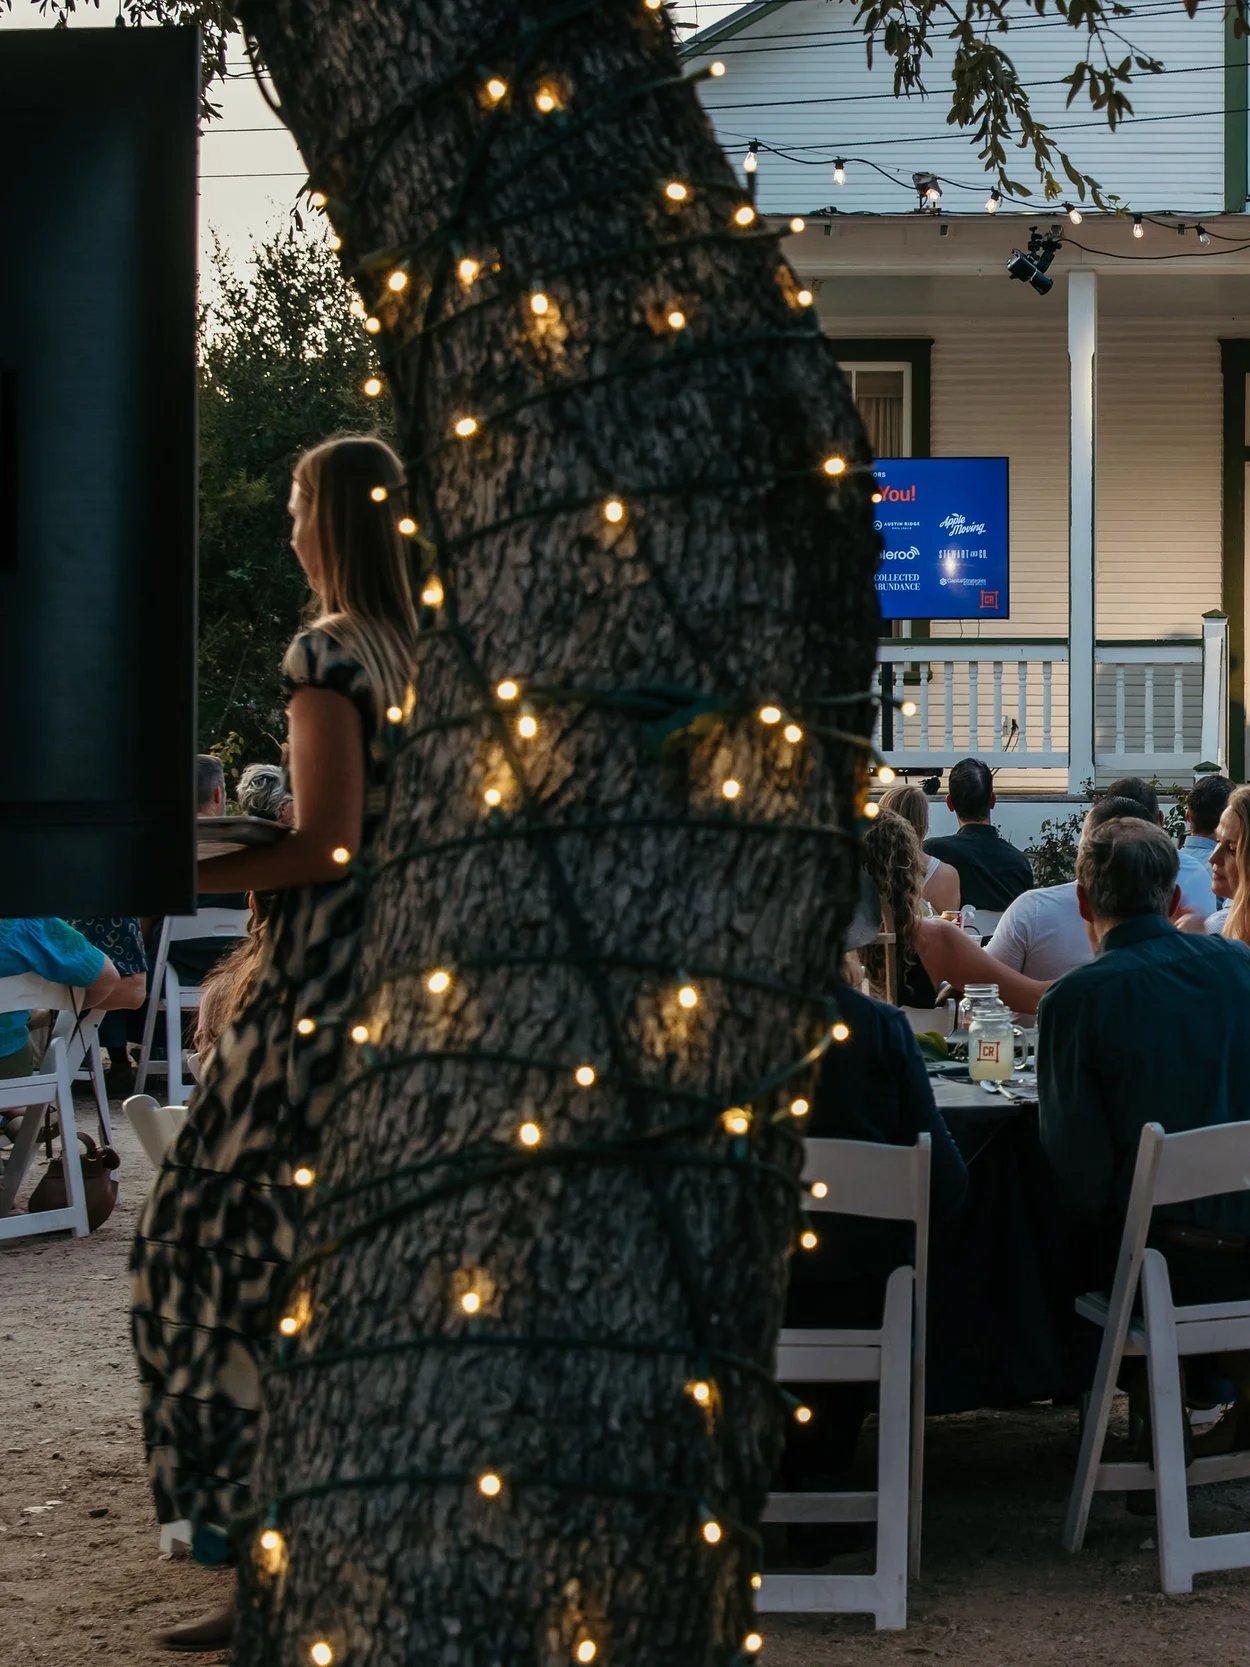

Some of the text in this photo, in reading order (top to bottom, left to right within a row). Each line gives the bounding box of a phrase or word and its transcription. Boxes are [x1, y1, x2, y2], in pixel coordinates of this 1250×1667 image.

[879, 485, 916, 502] You!
[939, 513, 966, 528] Apple
[948, 522, 986, 536] Moving
[938, 549, 969, 559] STEWART
[873, 573, 920, 582] COLLECTED
[983, 1046, 994, 1056] CR
